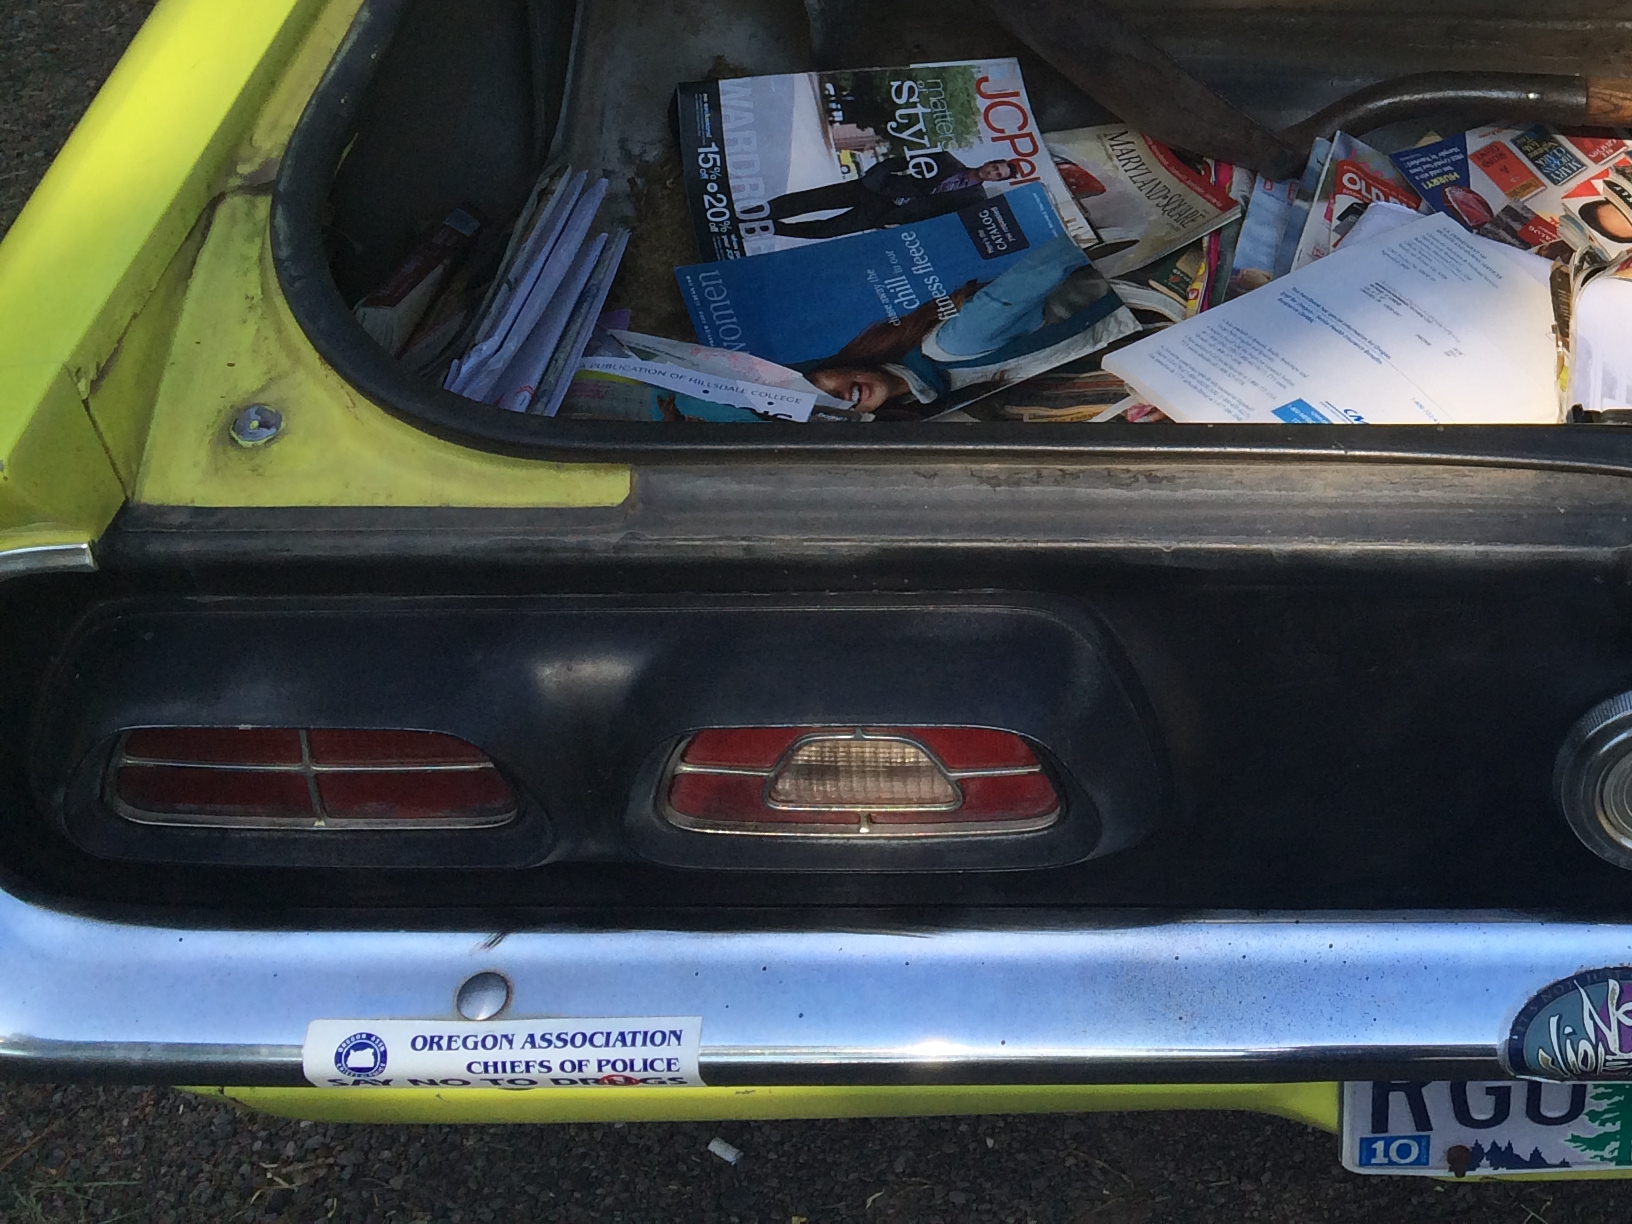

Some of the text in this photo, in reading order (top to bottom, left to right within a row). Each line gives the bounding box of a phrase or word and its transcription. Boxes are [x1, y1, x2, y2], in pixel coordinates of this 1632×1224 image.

[926, 79, 959, 151] matters
[887, 80, 943, 179] style
[720, 78, 775, 256] WARDROBE
[1535, 146, 1567, 167] CLARK
[1420, 171, 1460, 190] HURRY!
[1551, 159, 1583, 182] MARY
[1342, 172, 1385, 203] OLD
[979, 210, 1007, 250] CATALOG
[886, 250, 898, 264] our
[867, 268, 878, 283] the
[901, 231, 959, 320] fitness fleece
[874, 284, 889, 303] away
[884, 275, 920, 309] chill
[591, 362, 667, 377] PUBLICATION
[669, 372, 684, 381] OF
[688, 376, 747, 394] HILLSDALE
[751, 390, 802, 405] COLLEGE
[410, 1029, 684, 1052] OREGON ASSOCIATION
[466, 1056, 681, 1075] CHIEFS OF POLICE
[327, 1078, 393, 1087] SAY
[407, 1078, 463, 1087] NO
[489, 1078, 538, 1087] TO
[1370, 1139, 1419, 1164] 10
